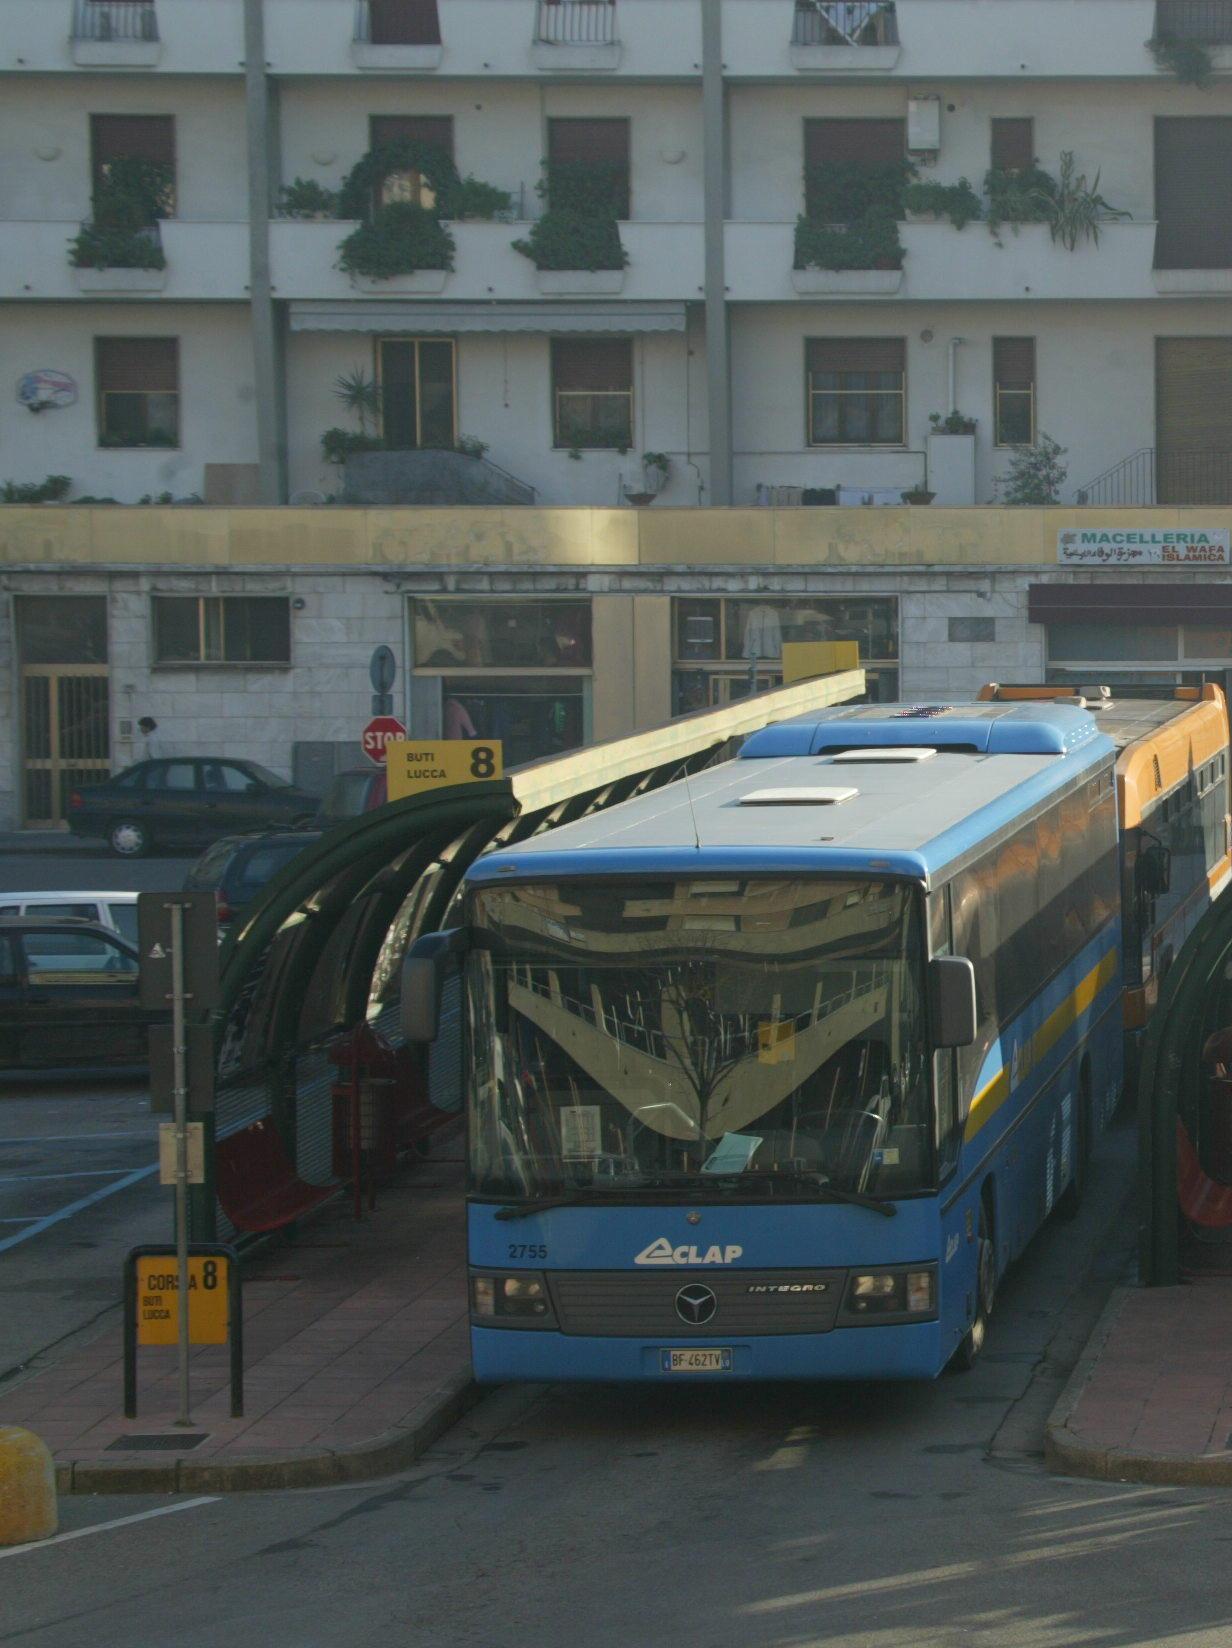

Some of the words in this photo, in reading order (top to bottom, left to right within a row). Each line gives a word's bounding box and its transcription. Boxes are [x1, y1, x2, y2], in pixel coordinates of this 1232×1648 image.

[1081, 532, 1210, 544] MACELLERIA
[1162, 545, 1178, 553] EL
[1186, 545, 1224, 553] WAFA
[1162, 554, 1225, 562] ISLAMICA
[406, 752, 434, 762] BUTI
[470, 746, 495, 778] 8
[406, 769, 446, 778] LUCCA
[508, 1244, 548, 1259] 2755
[147, 1274, 198, 1291] CORSA
[203, 1260, 217, 1290] 8
[748, 1284, 826, 1292] INTEGRO
[143, 1296, 162, 1306] BUTI
[143, 1310, 170, 1319] LUCCA
